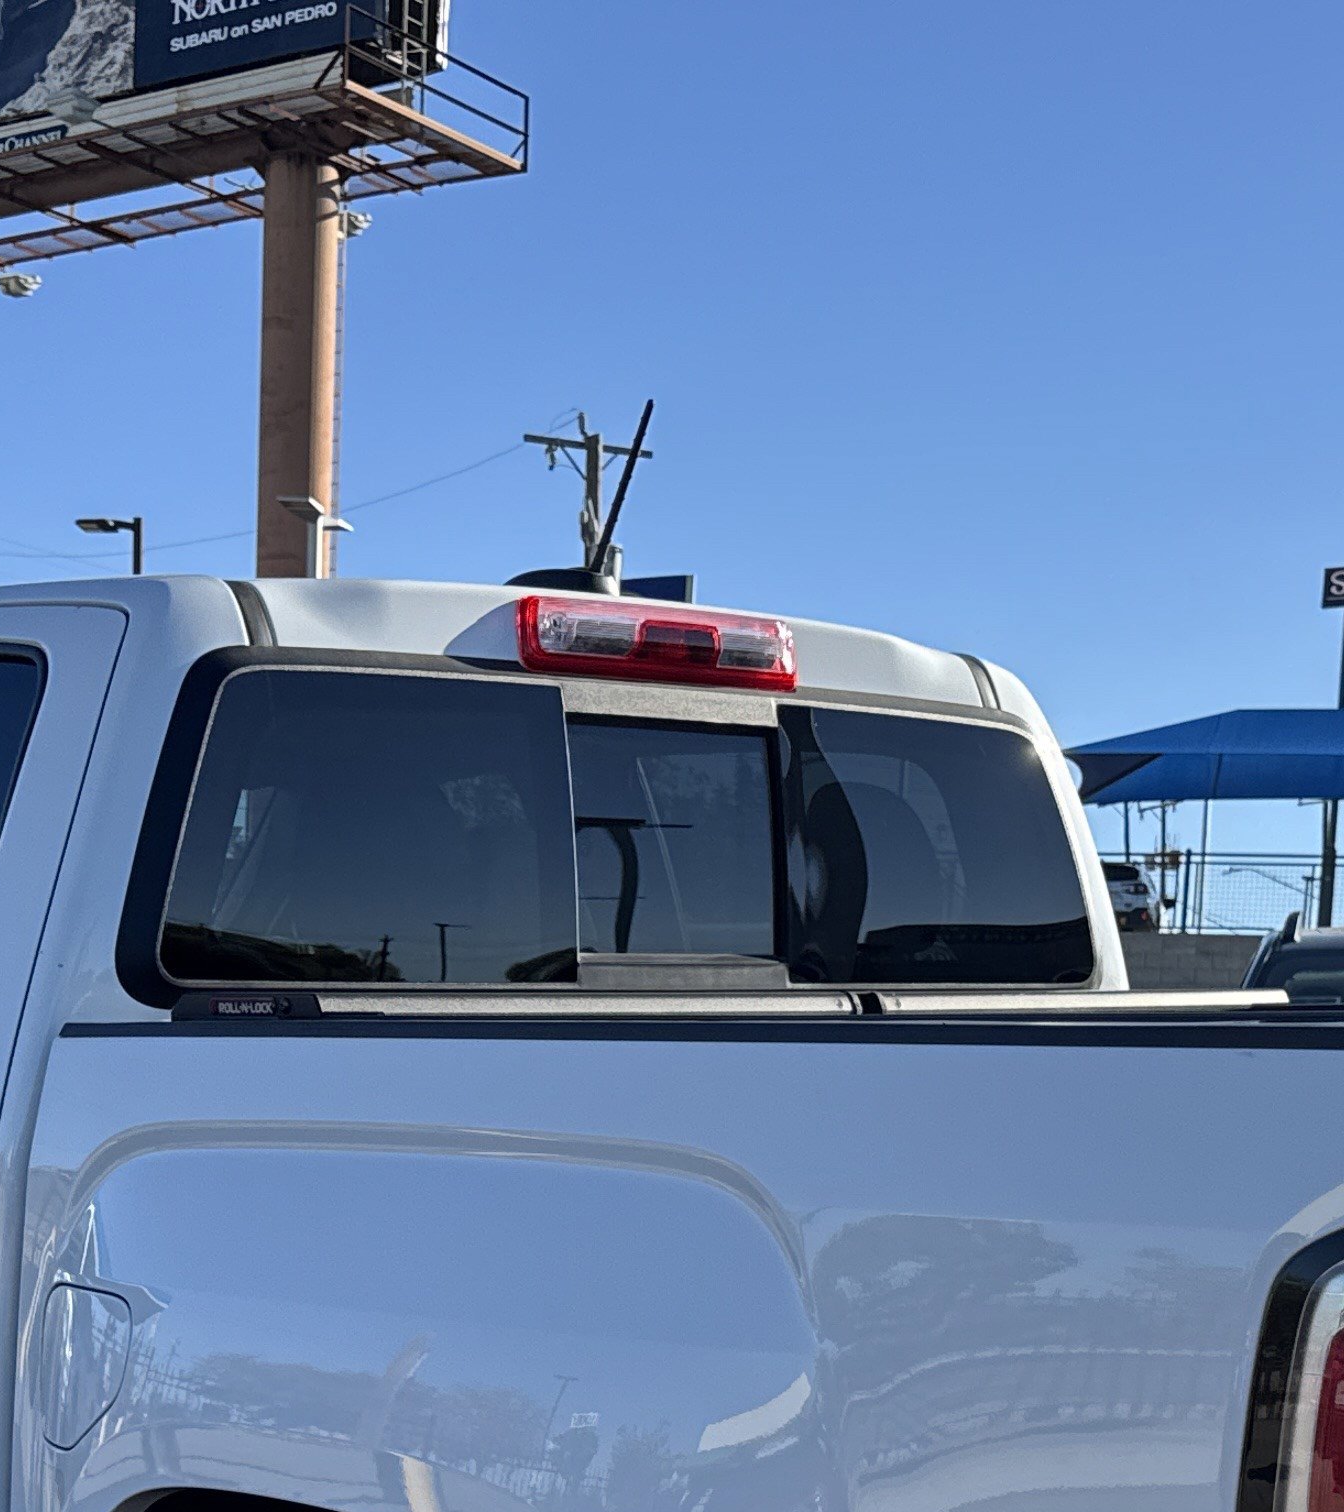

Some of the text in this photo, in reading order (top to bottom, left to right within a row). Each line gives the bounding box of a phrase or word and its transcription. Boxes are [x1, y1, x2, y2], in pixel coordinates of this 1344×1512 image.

[169, 2, 337, 52] SUBARU on SAN PEDRO
